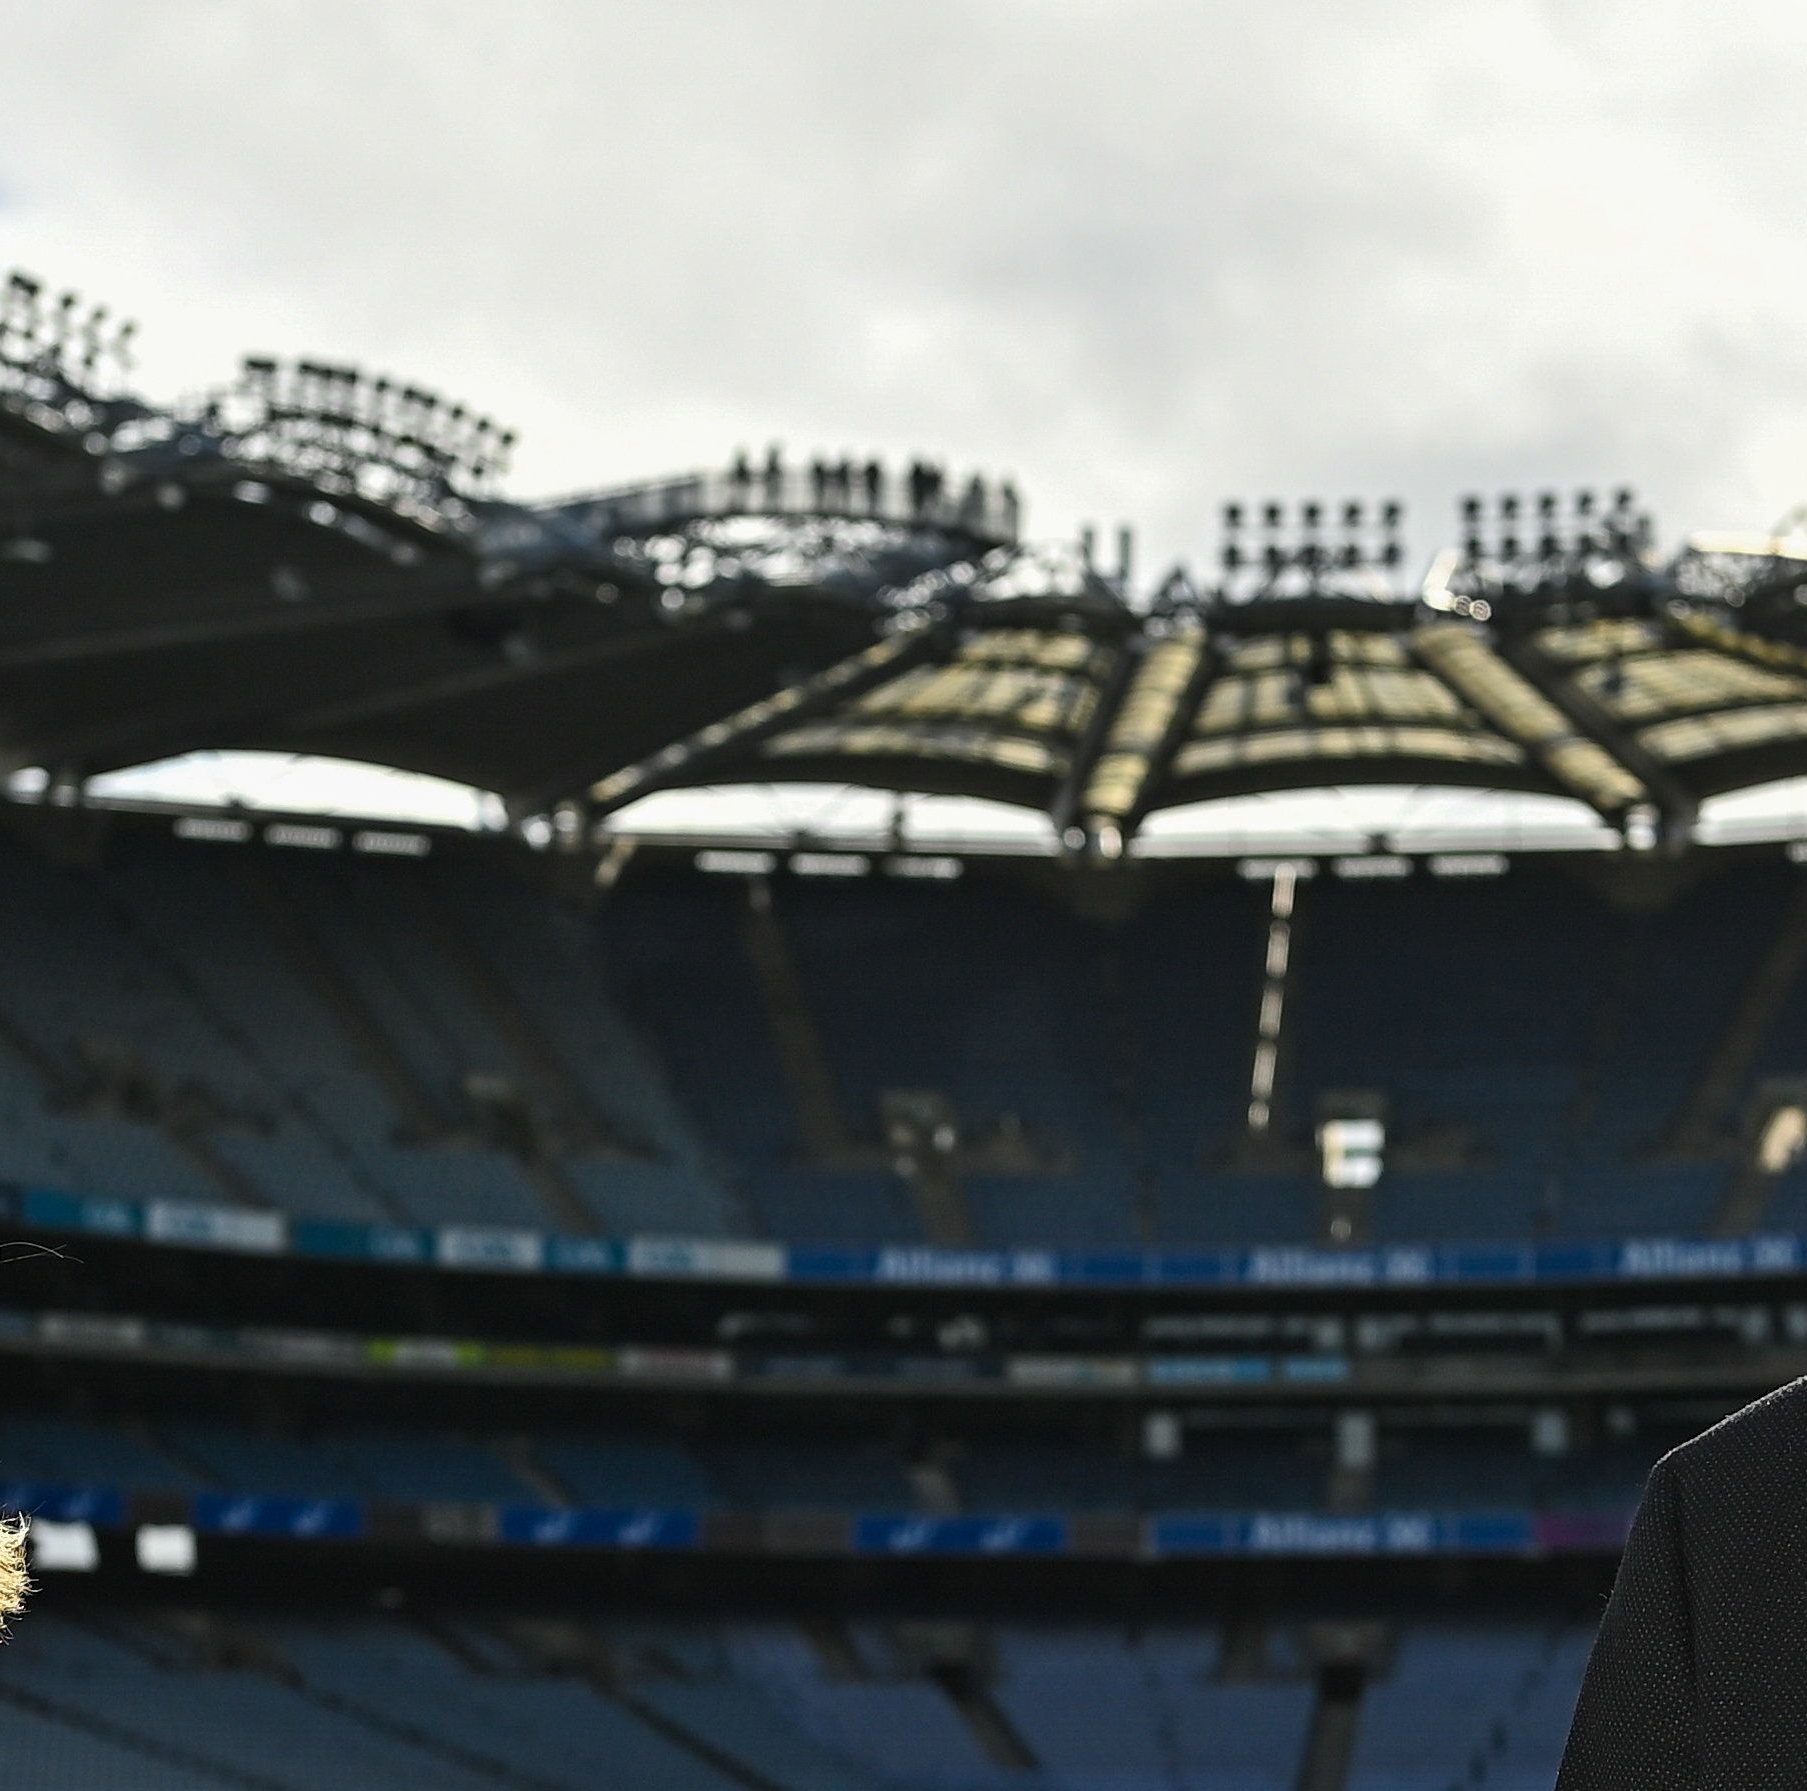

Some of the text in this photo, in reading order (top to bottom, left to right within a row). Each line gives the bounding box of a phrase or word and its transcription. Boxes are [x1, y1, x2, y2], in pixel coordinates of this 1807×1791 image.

[875, 1247, 1001, 1284] Allianz
[1248, 1246, 1373, 1284] Allianz
[1621, 1239, 1743, 1276] Allianz
